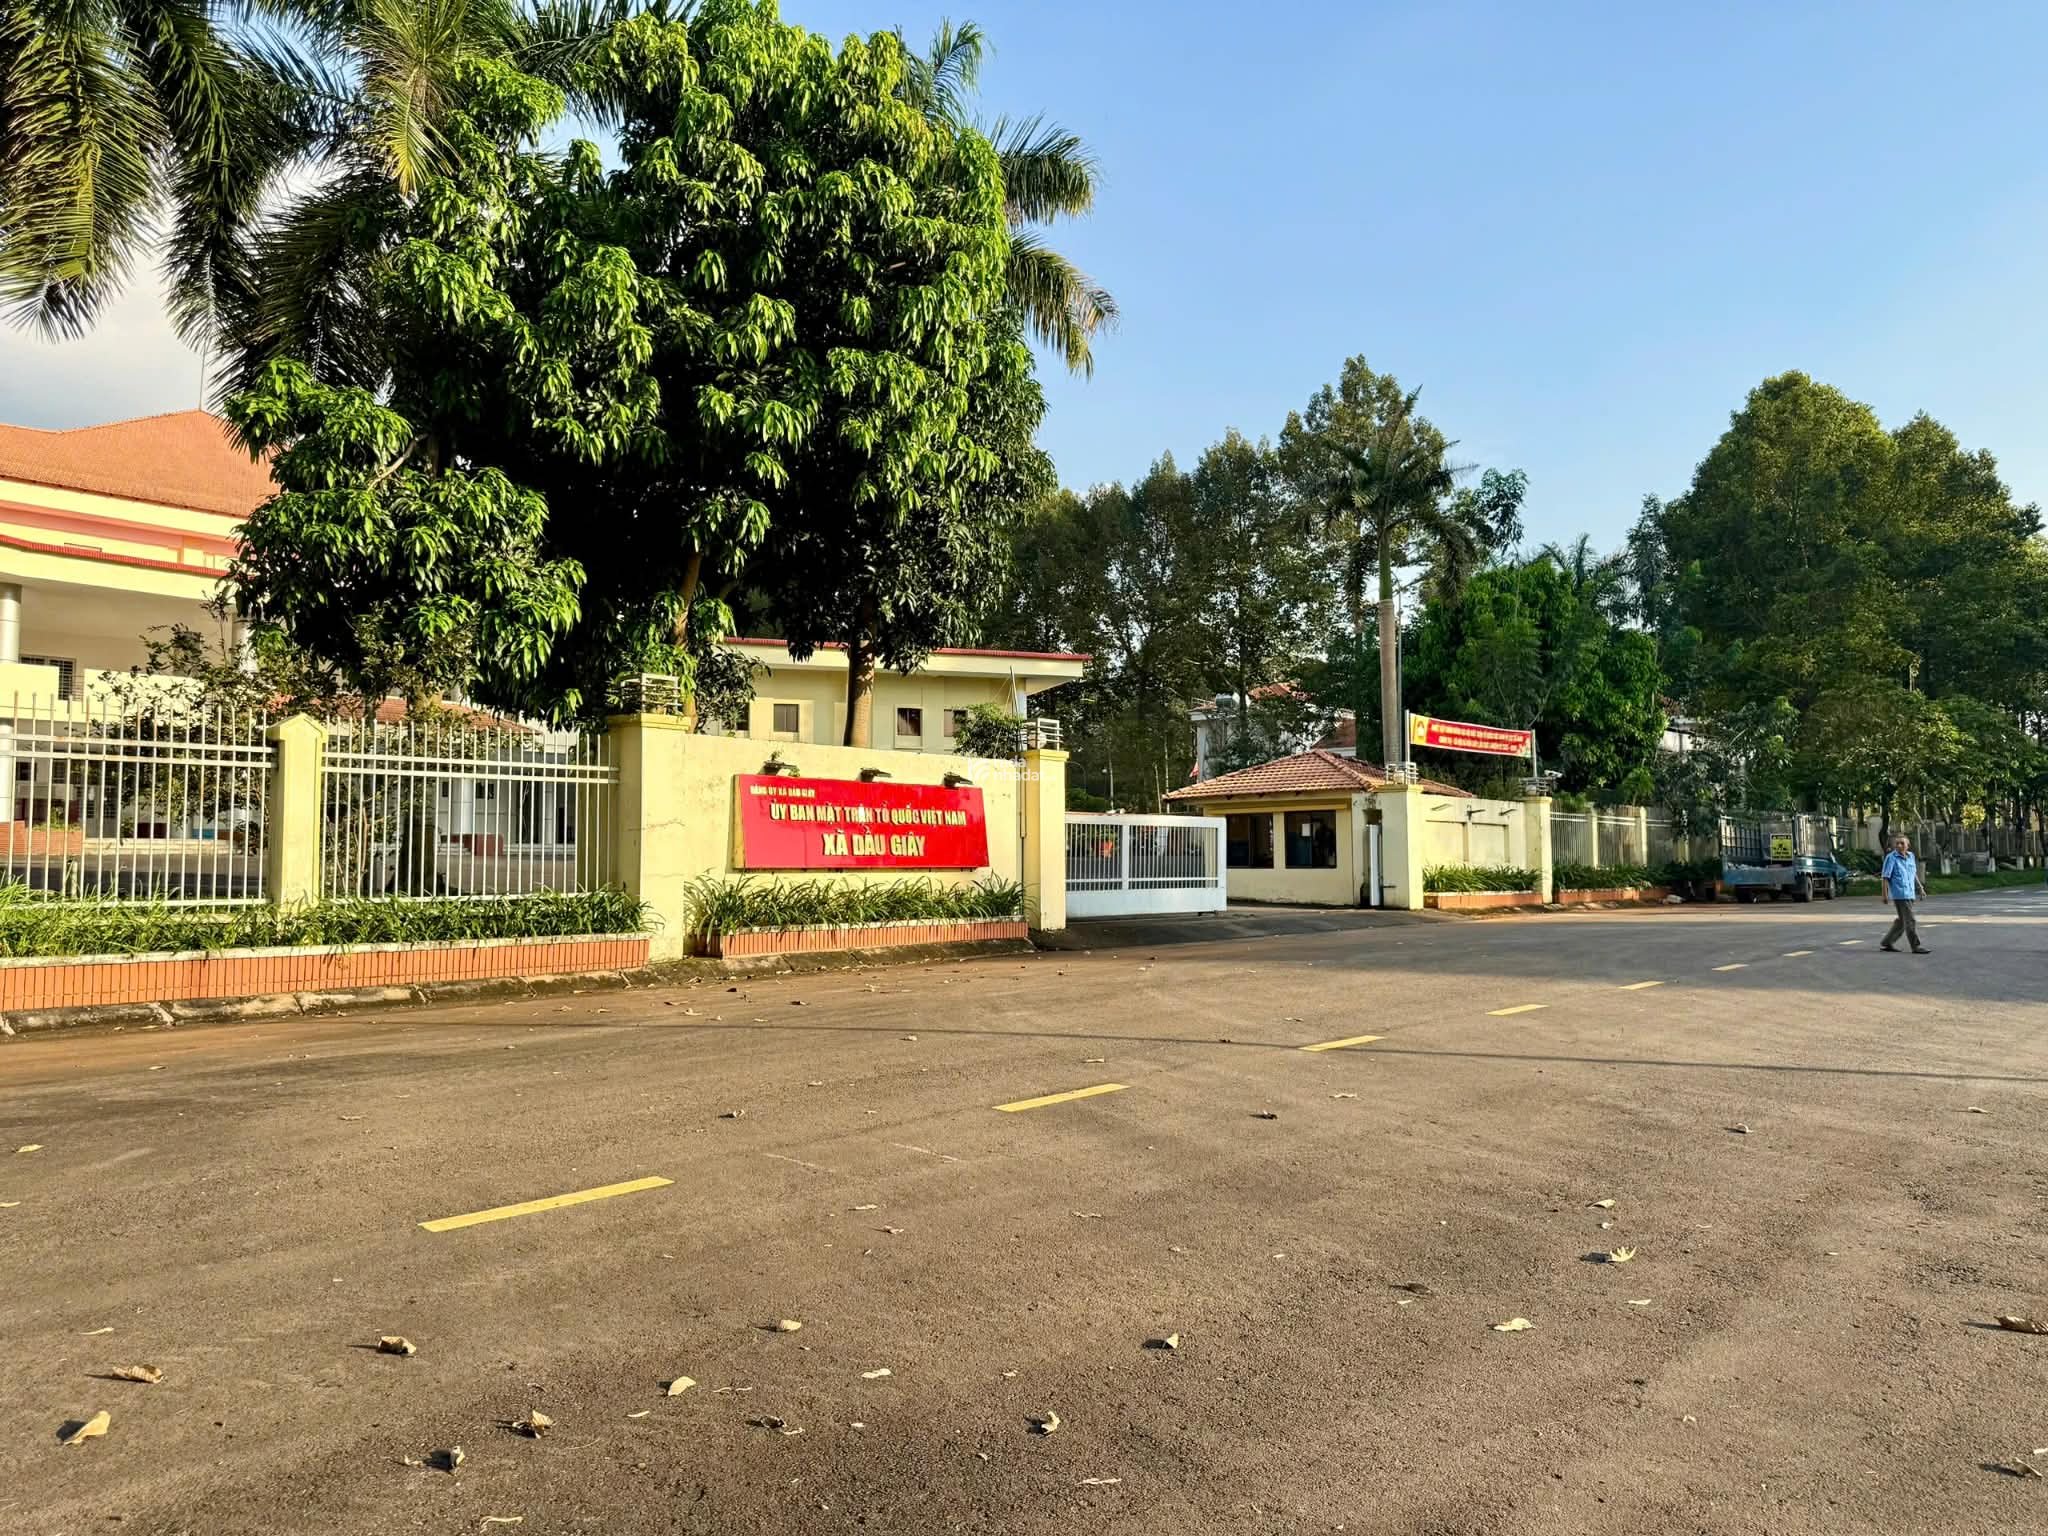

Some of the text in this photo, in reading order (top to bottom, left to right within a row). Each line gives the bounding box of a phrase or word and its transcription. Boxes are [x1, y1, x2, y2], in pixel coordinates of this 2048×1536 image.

[770, 798, 967, 828] ỦY BAN MẶT TRẬN TỔ QUỐC VIỆT NAM
[822, 825, 926, 857] XÃ DẦU GIÂY
